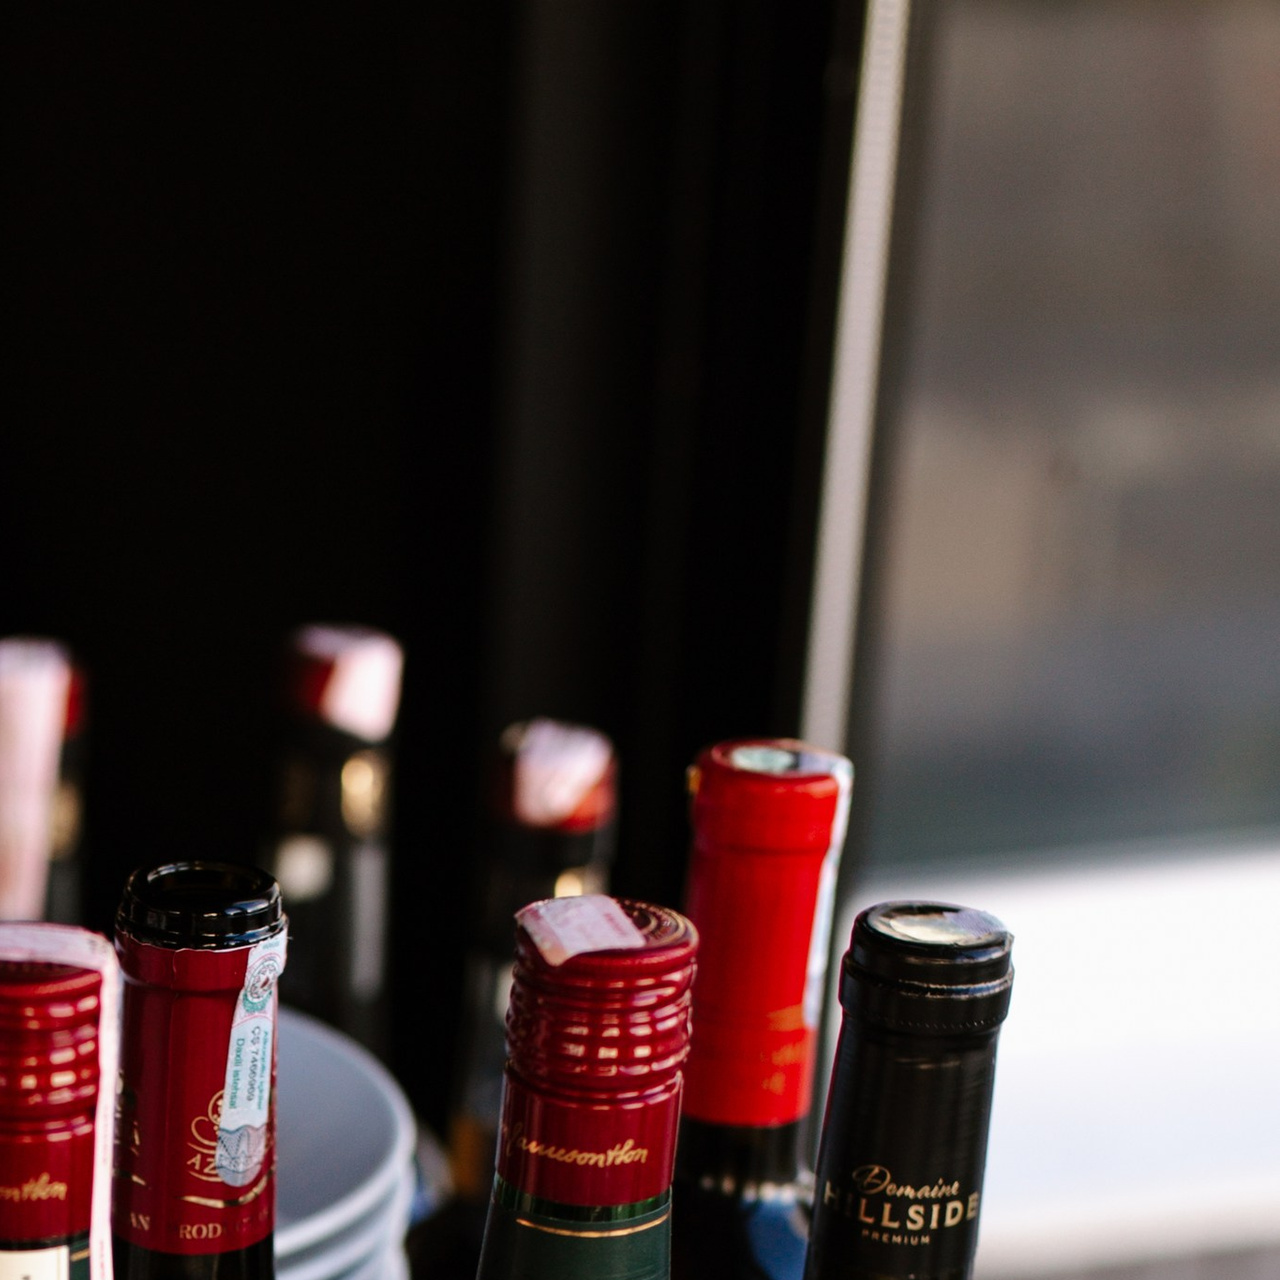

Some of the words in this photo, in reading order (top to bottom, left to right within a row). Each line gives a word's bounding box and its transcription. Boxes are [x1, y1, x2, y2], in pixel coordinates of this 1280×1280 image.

[234, 1038, 246, 1067] Daxili
[851, 1164, 960, 1199] Domaine
[861, 1228, 931, 1247] PREMIUM
